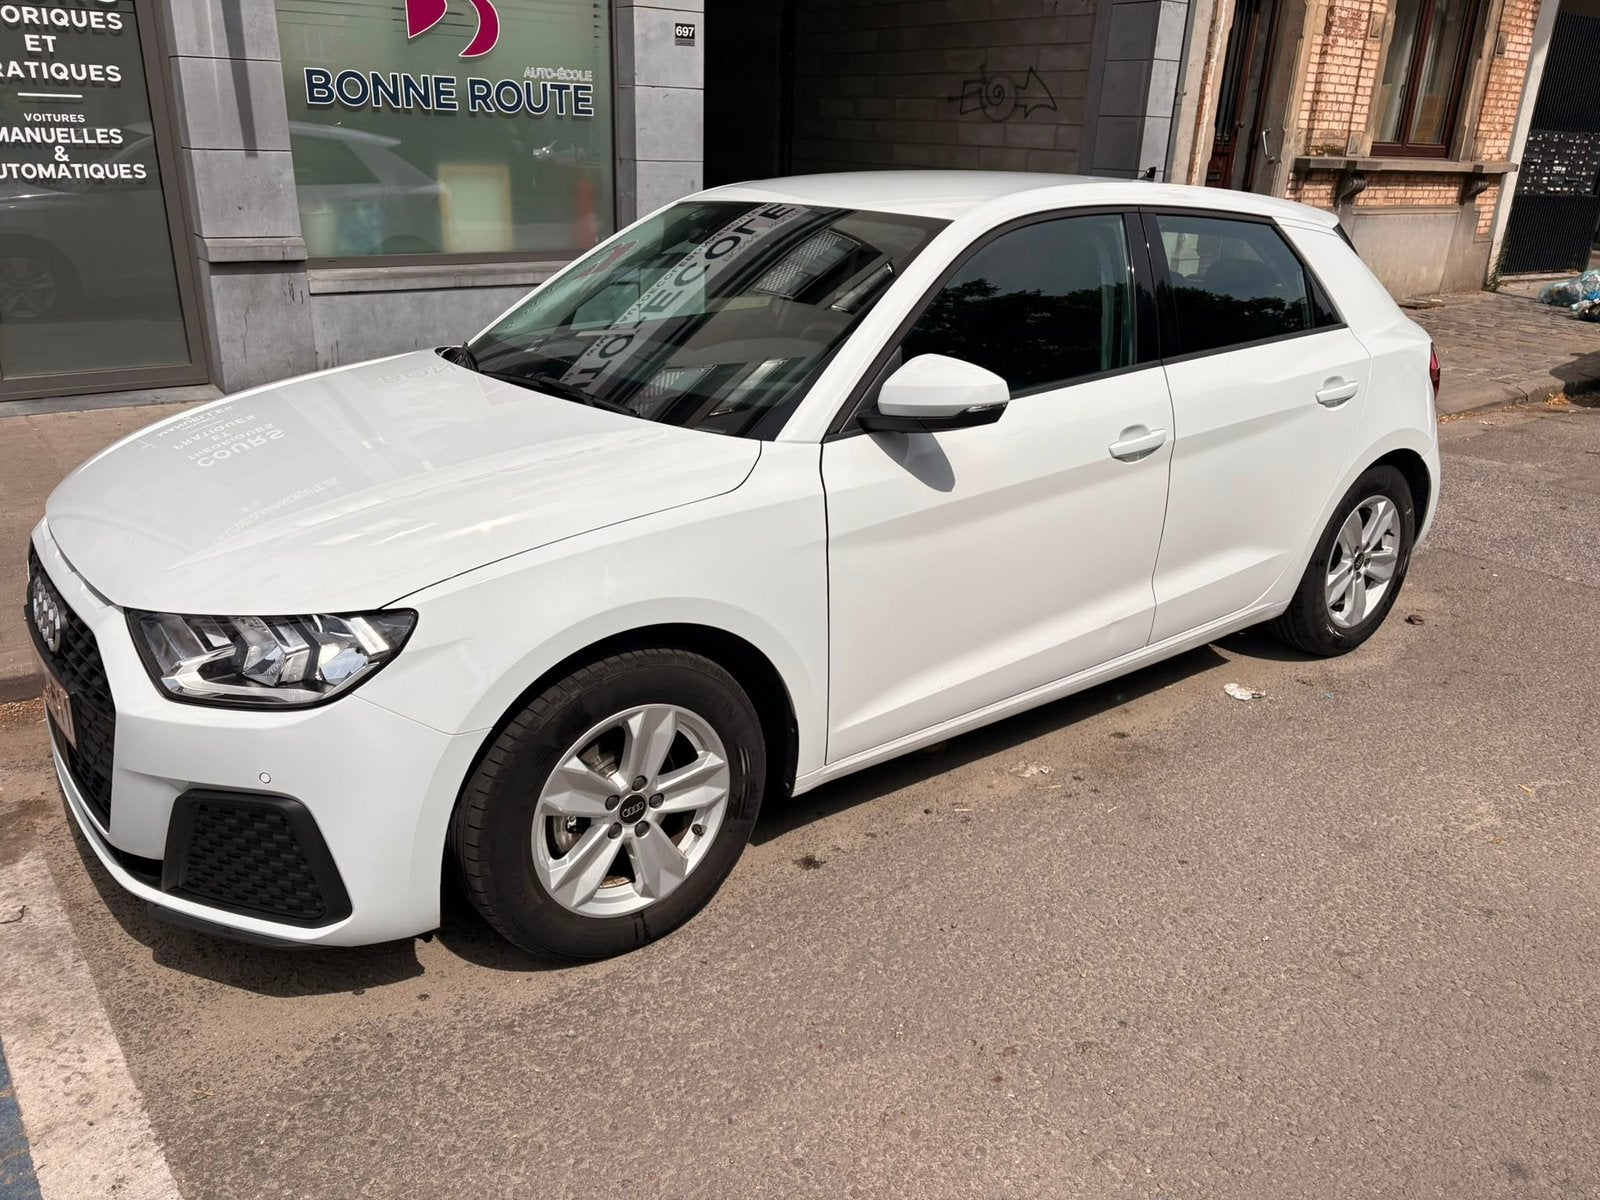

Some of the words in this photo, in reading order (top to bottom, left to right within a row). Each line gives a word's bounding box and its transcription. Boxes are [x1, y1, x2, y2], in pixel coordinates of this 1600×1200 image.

[0, 5, 123, 30] ORIQUES
[676, 26, 695, 37] 697
[24, 34, 57, 53] ET
[0, 60, 122, 82] ATIQUES
[523, 66, 593, 82] AUTO-ÉCOLE
[304, 67, 459, 111] BONNE
[467, 77, 594, 117] ROUTE
[23, 112, 86, 123] VOITURES
[54, 145, 70, 162] &
